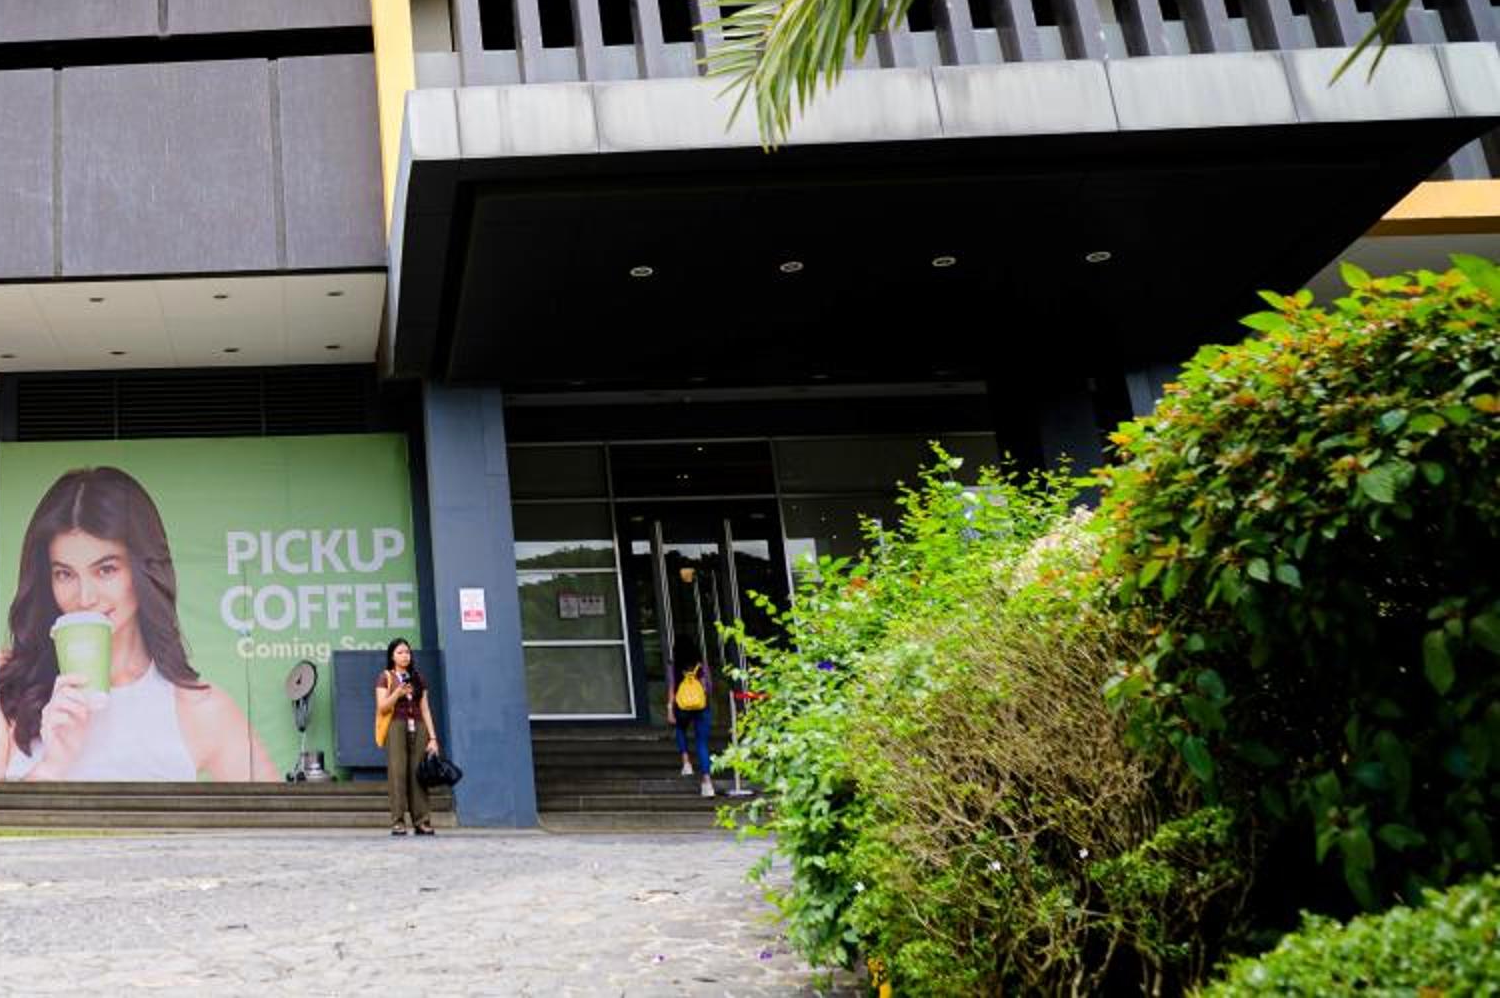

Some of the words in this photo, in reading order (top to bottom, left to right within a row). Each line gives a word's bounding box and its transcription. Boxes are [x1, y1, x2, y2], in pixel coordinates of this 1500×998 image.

[227, 527, 406, 576] PICKUP
[219, 582, 417, 632] COFFEE
[236, 636, 331, 663] Coming
